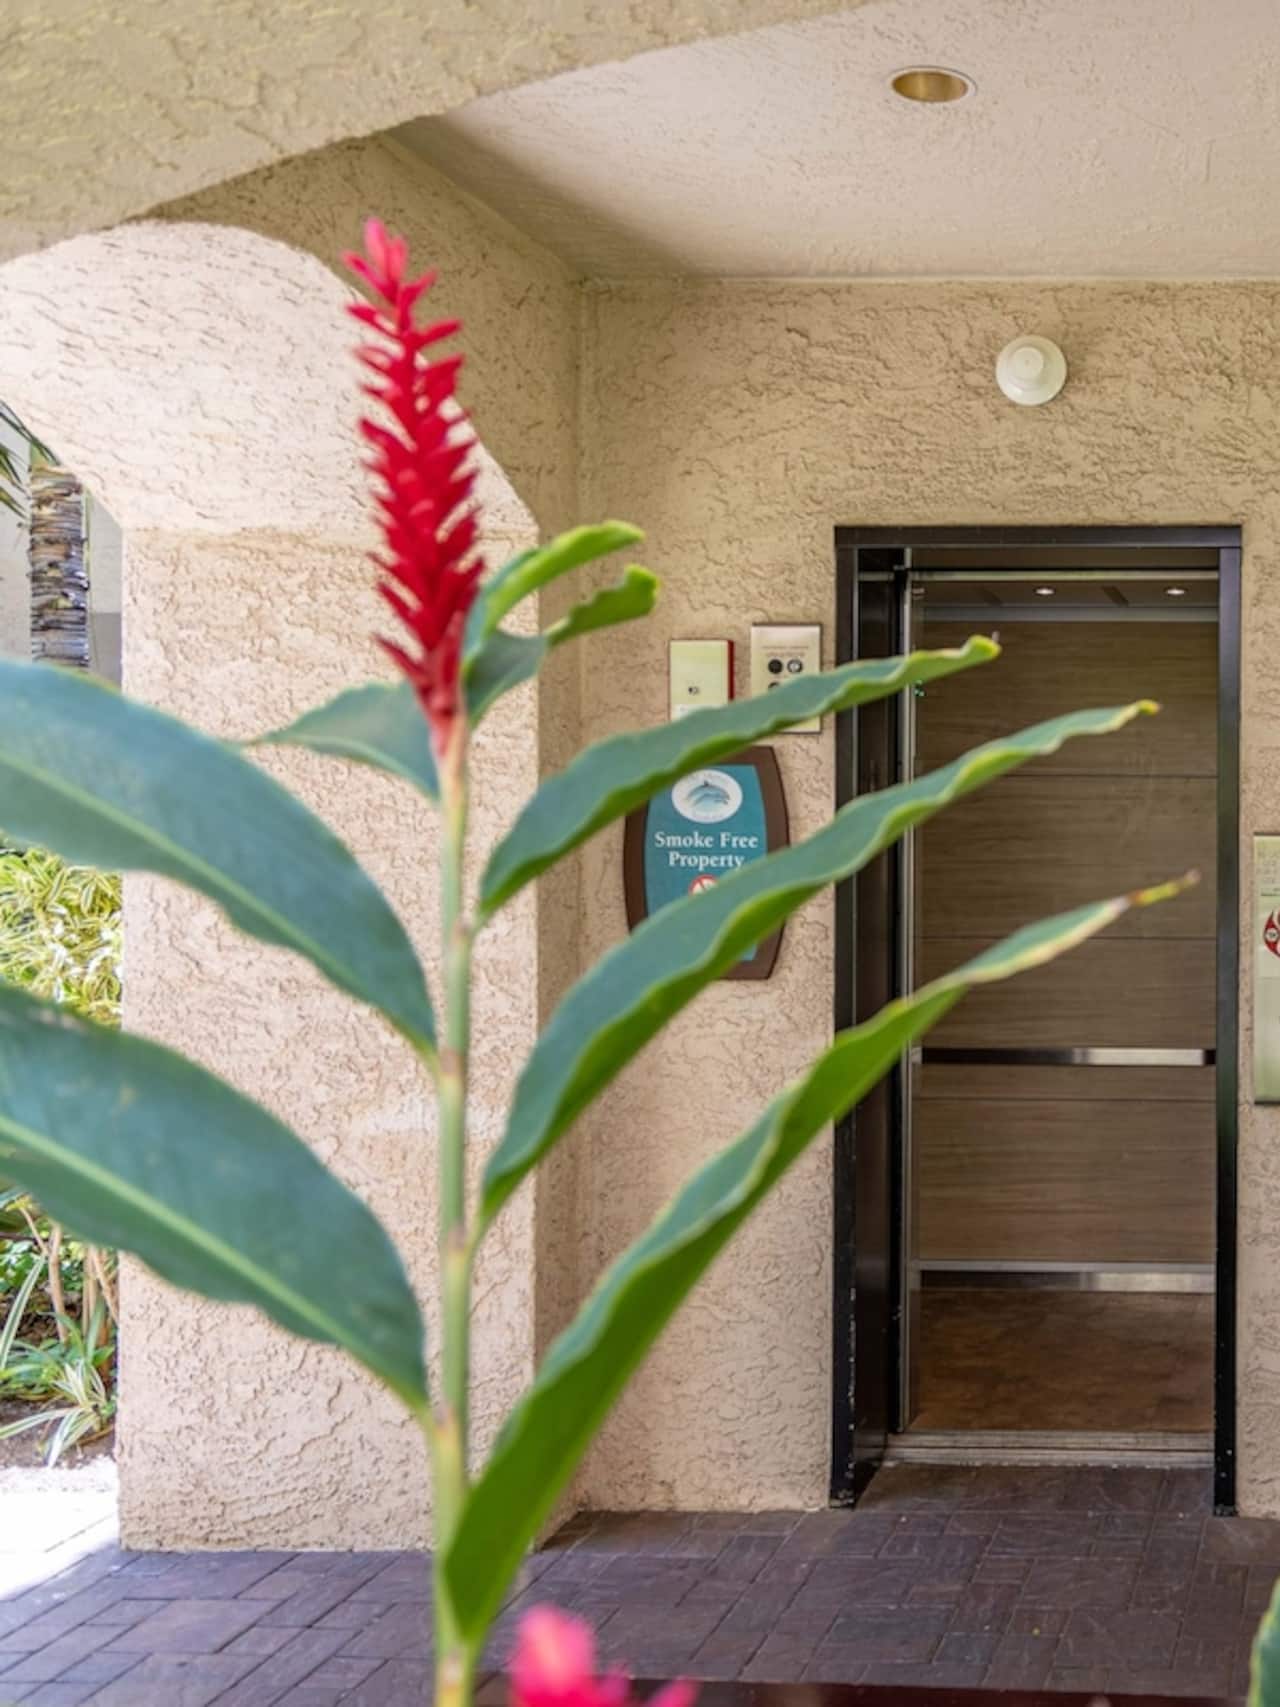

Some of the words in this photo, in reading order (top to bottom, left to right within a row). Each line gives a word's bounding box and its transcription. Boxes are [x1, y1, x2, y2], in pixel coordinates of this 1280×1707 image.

[654, 831, 714, 849] Smoke
[719, 832, 759, 849] Free
[668, 851, 746, 872] Property
